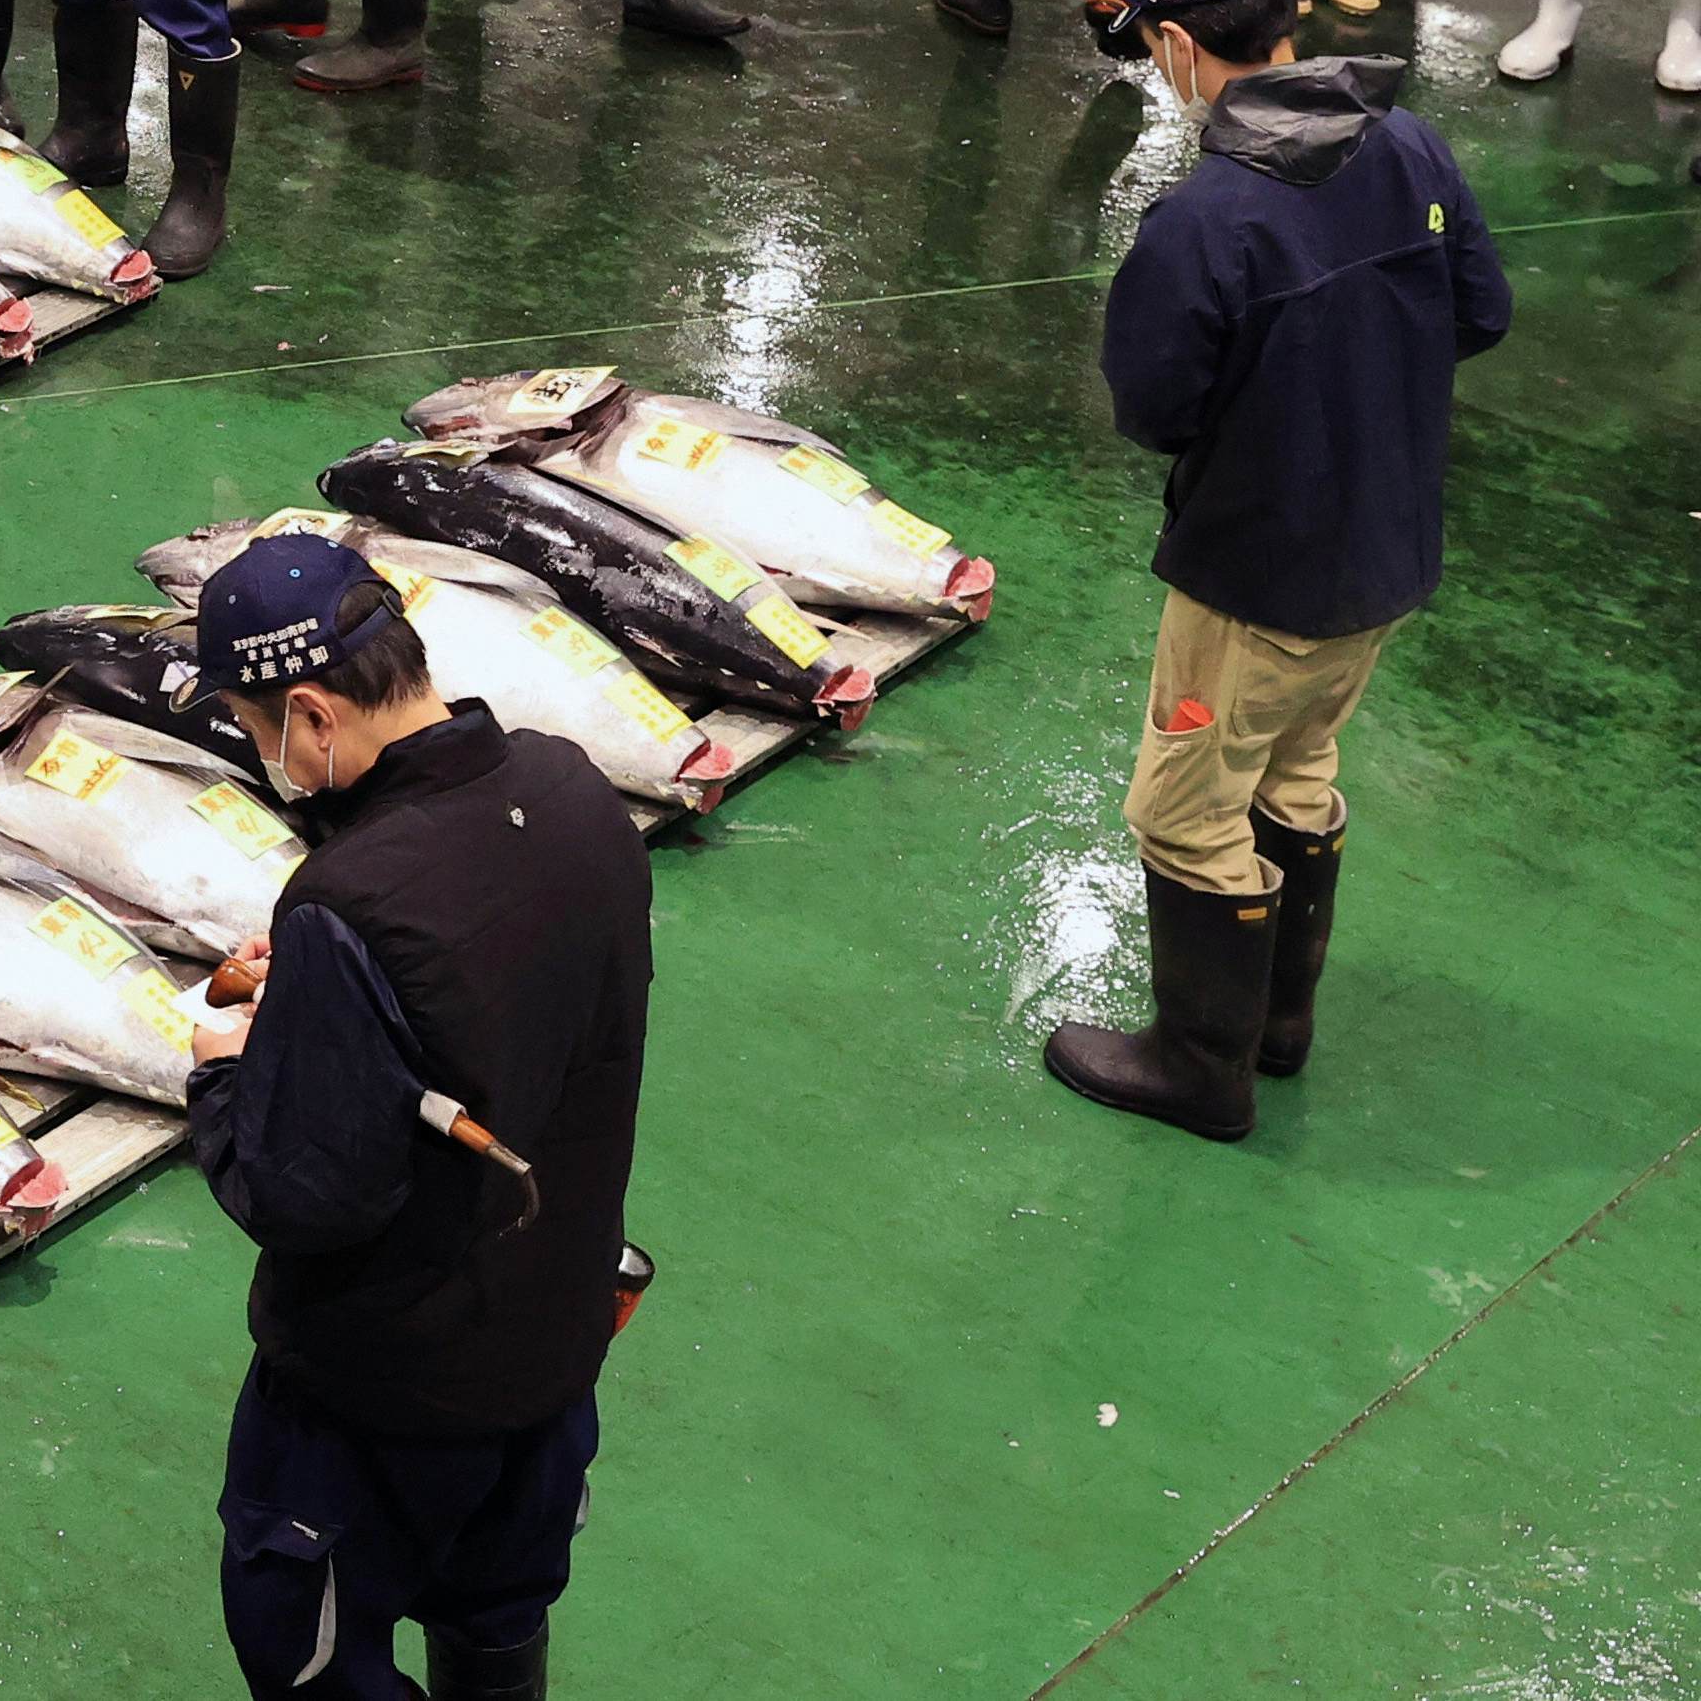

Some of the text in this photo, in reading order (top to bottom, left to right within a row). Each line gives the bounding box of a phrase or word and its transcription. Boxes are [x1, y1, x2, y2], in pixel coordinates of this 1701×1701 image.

[231, 617, 319, 652] 東京都中央卸売市場
[239, 645, 330, 683] 水産仲卸
